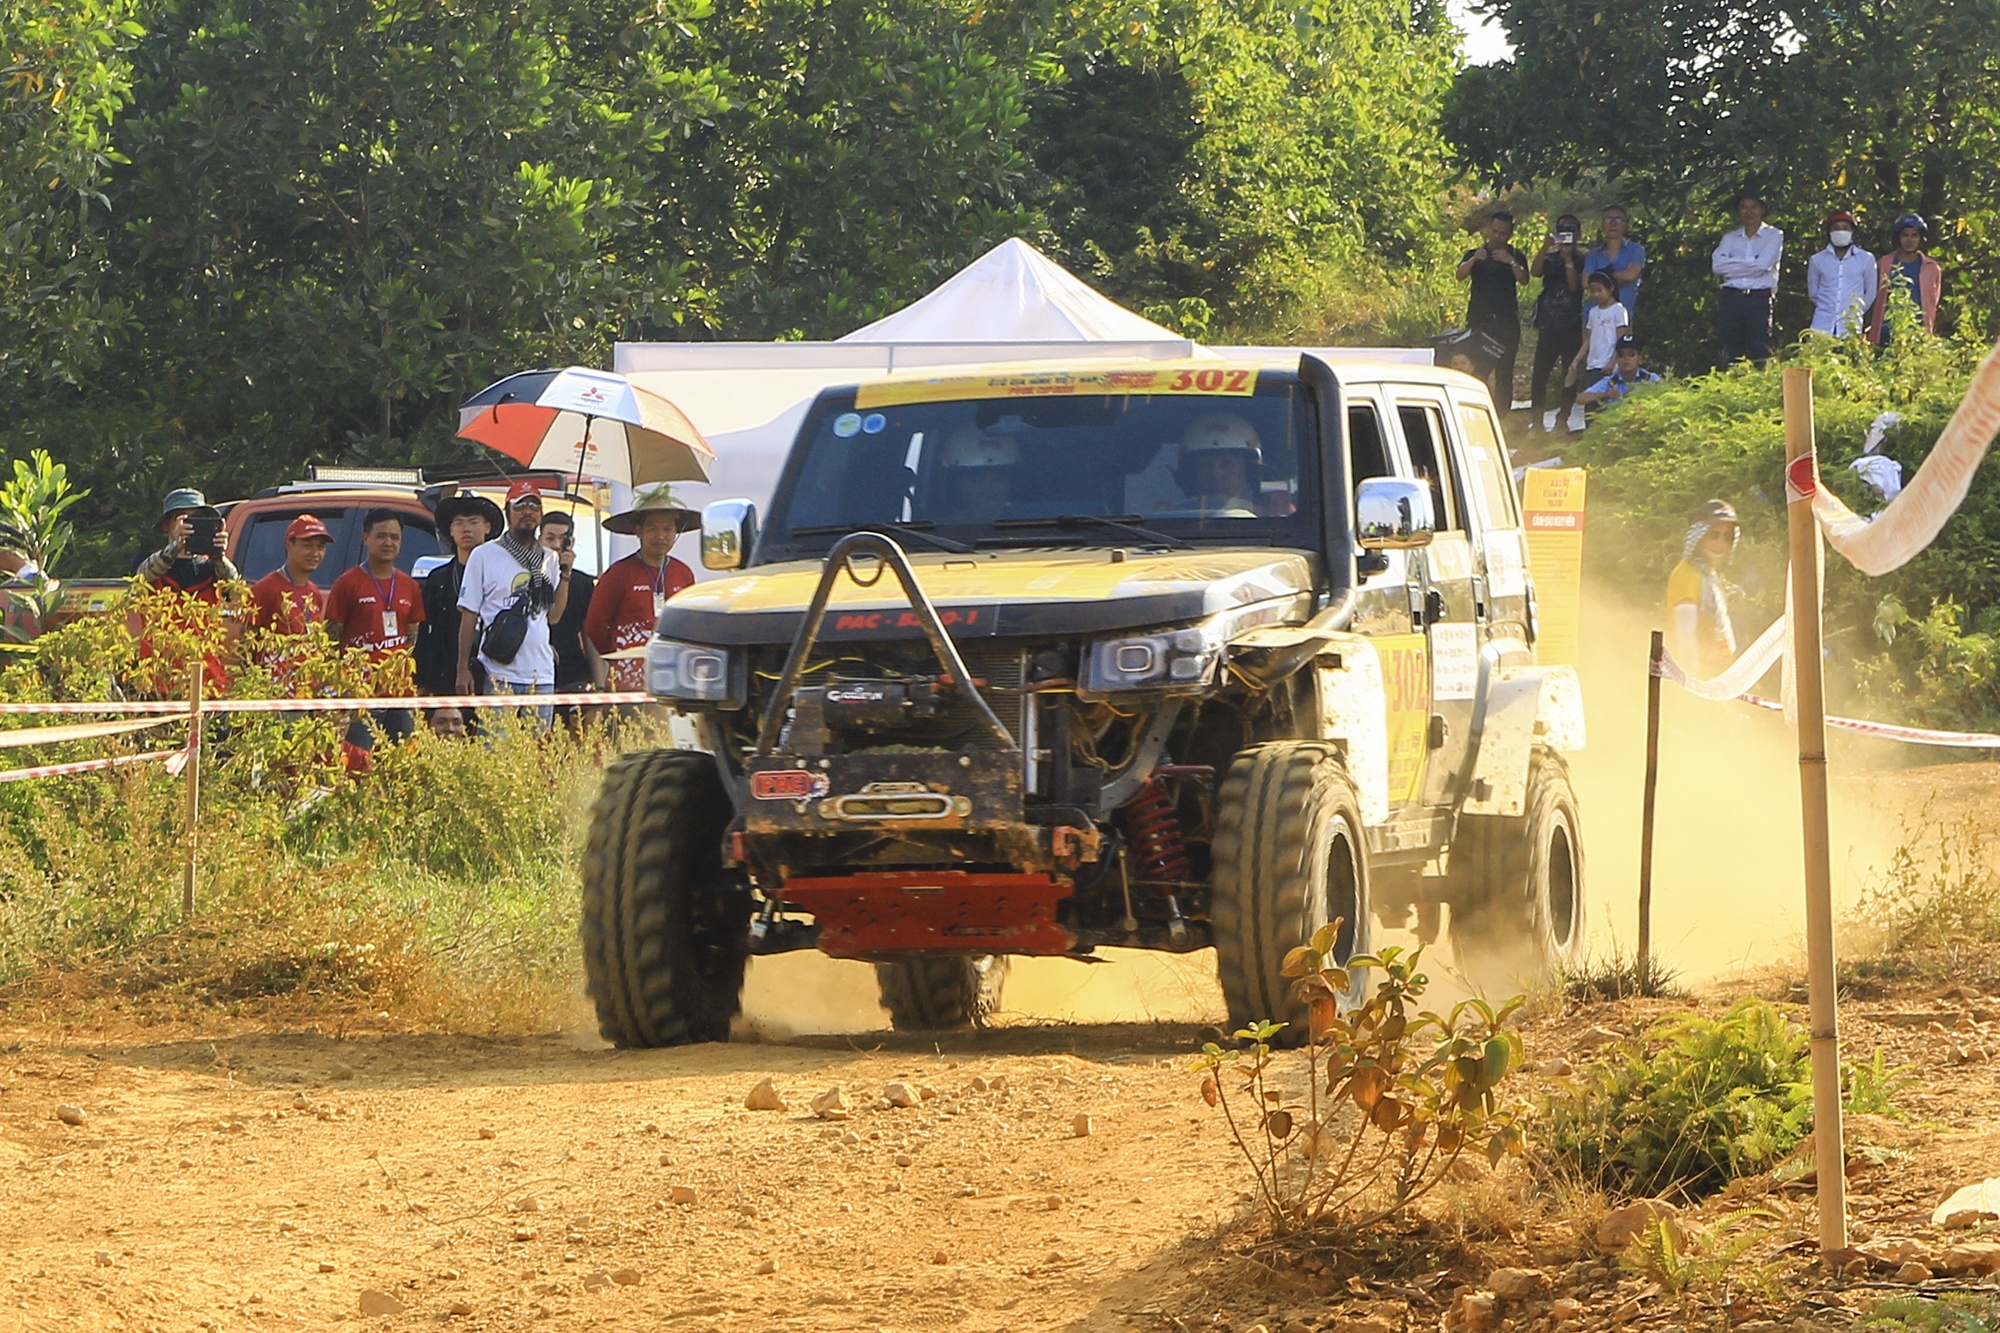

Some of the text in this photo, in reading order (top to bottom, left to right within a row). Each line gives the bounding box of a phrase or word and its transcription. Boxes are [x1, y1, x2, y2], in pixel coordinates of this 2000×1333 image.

[1169, 369, 1249, 391] 302
[835, 614, 882, 630] PAC
[1392, 649, 1425, 712] 302
[761, 778, 804, 793] PAC
